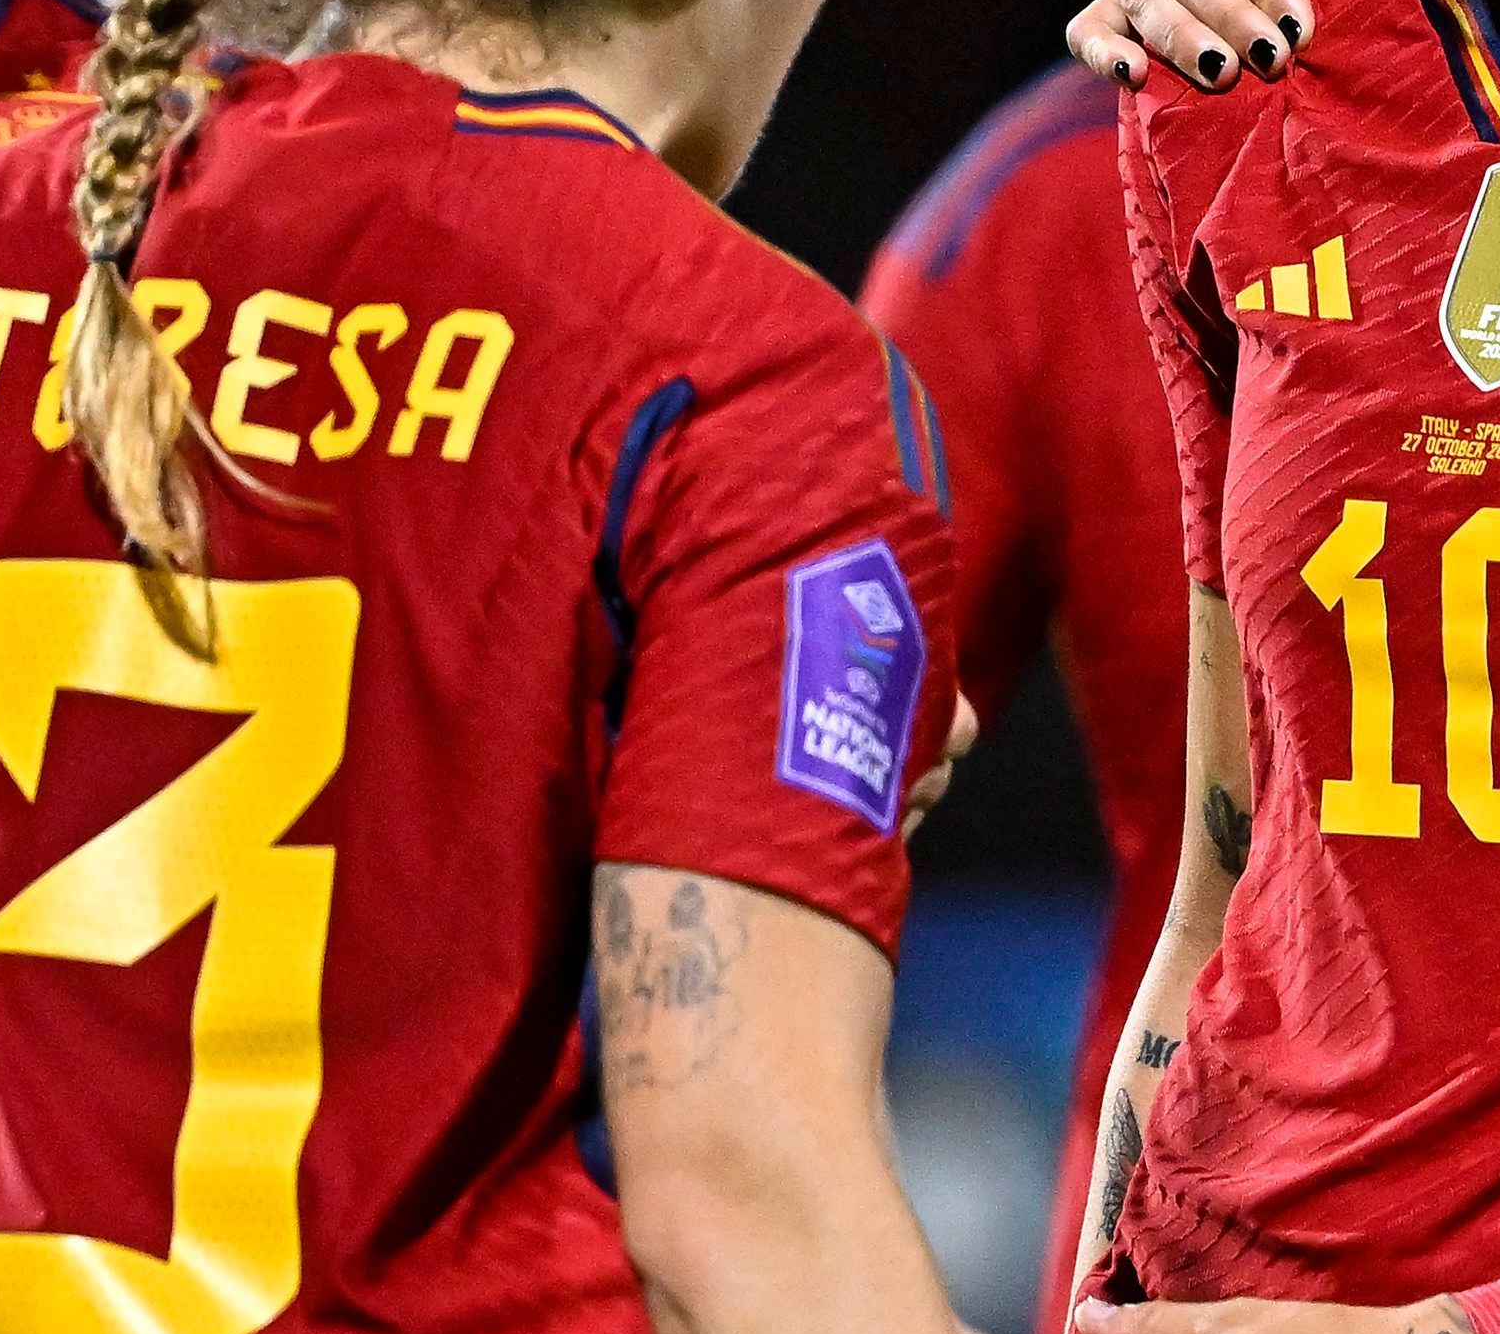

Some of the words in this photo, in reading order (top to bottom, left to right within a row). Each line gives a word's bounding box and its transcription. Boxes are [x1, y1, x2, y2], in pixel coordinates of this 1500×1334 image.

[1420, 415, 1459, 437] ITALY
[1401, 433, 1422, 452] 27
[1425, 436, 1485, 458] OCTOBER
[1427, 455, 1487, 476] SALERNO
